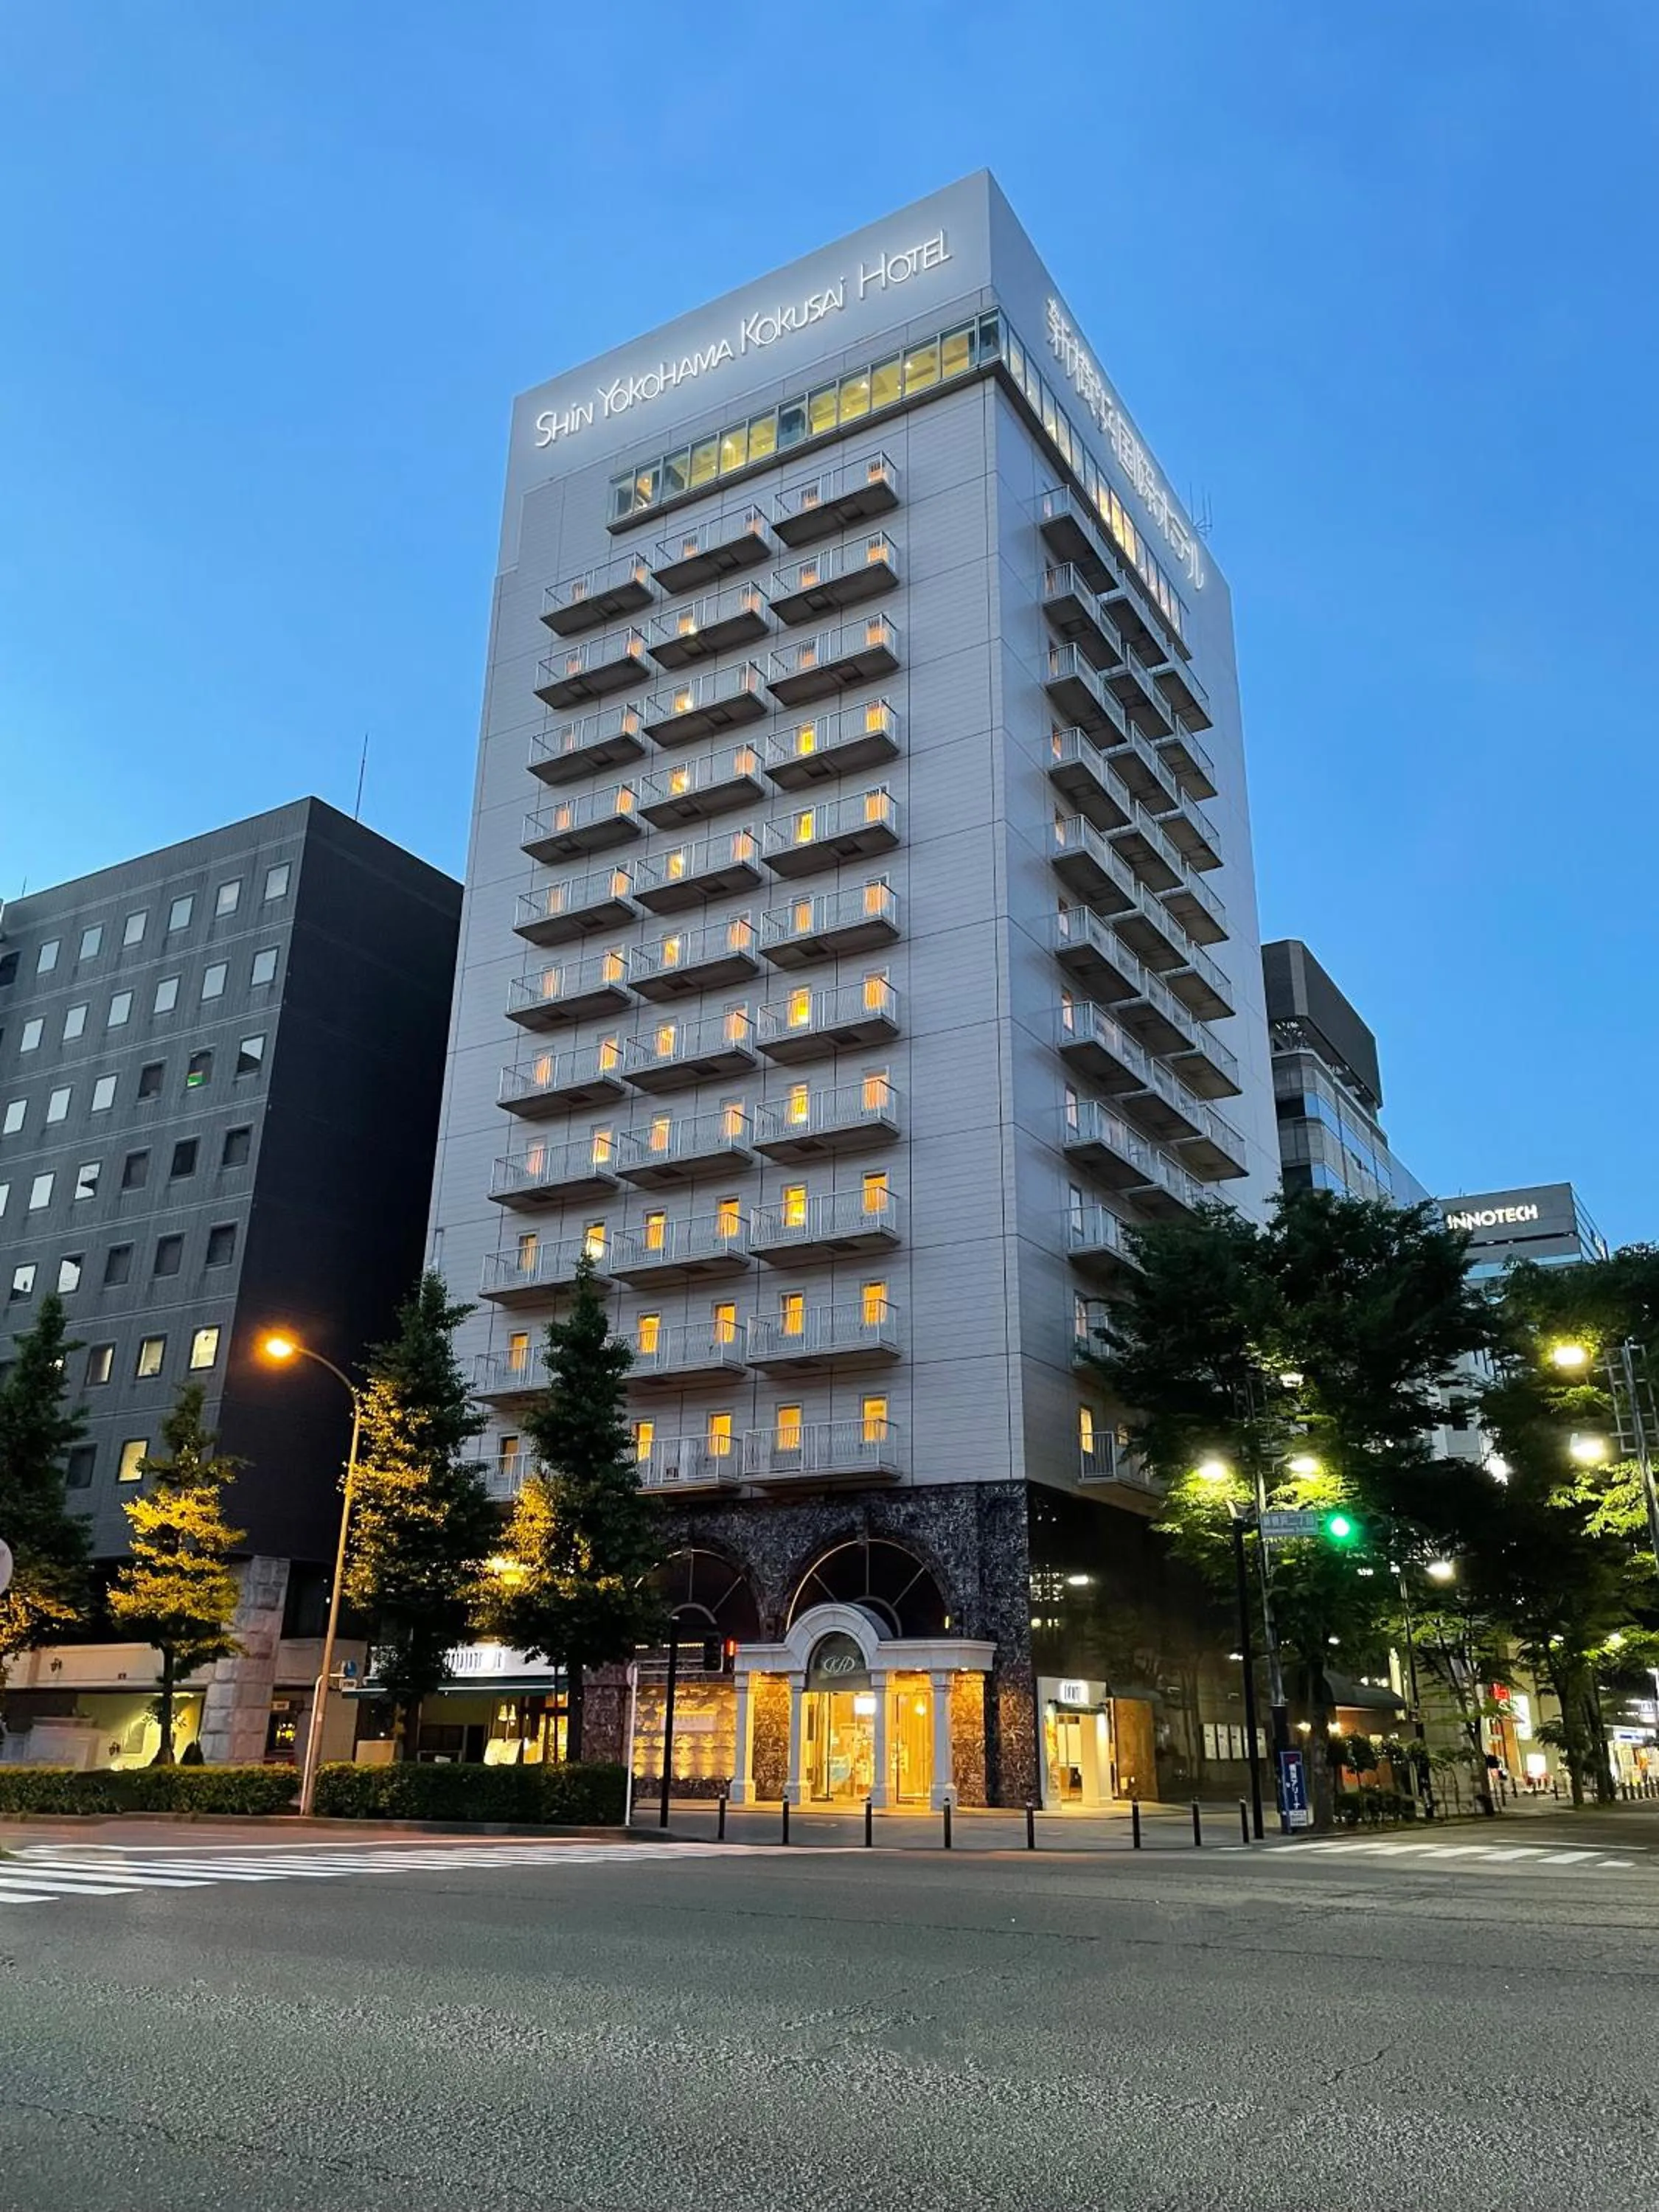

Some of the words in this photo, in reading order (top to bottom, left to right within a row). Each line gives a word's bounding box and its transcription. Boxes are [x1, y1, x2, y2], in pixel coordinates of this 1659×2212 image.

[597, 339, 734, 418] YOKOHAMA
[859, 228, 953, 300] HOTEL
[1047, 297, 1204, 590] 新横浜国際ホテル
